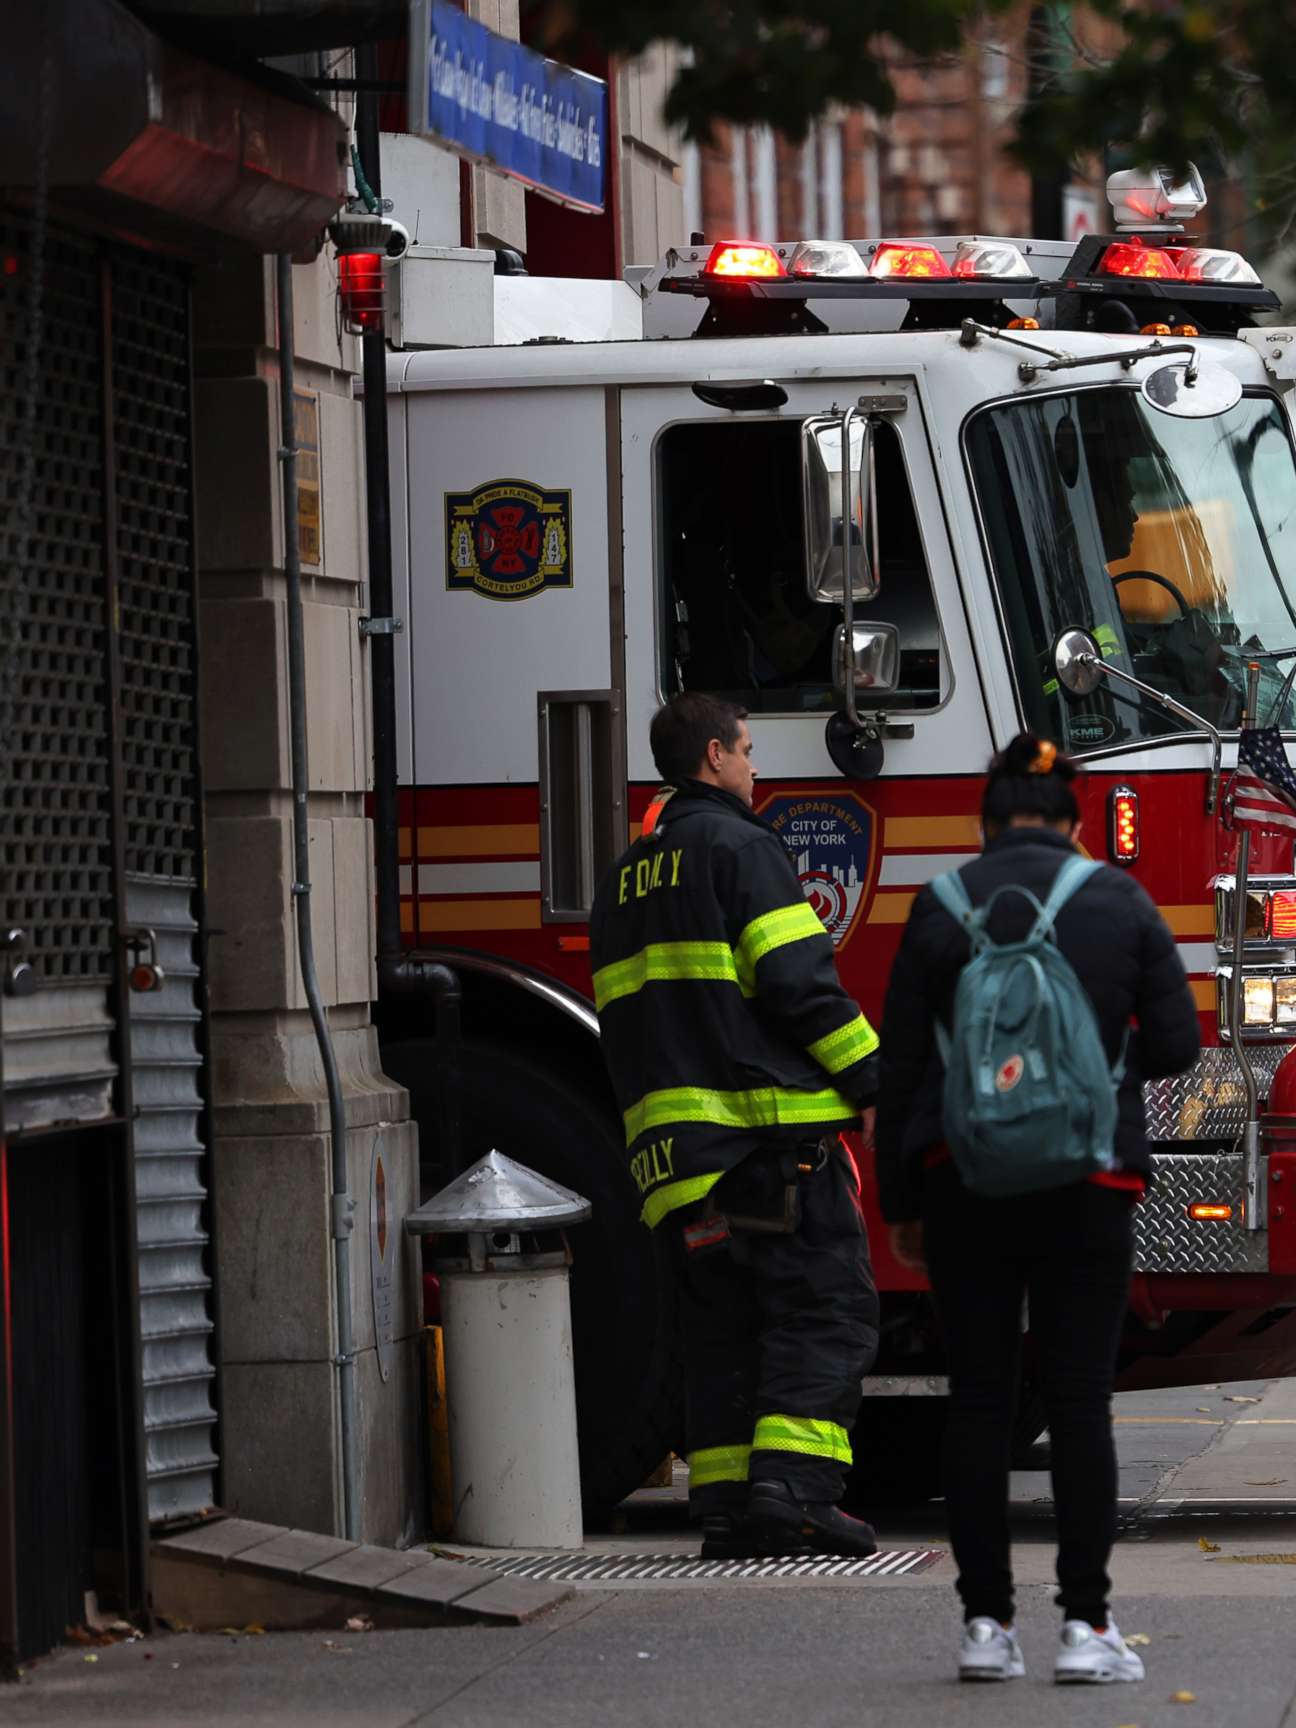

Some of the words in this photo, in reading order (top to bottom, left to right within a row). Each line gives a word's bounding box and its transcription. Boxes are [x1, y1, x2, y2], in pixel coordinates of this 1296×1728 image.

[550, 533, 558, 563] 147
[476, 576, 527, 592] CORTELYOU
[1070, 727, 1105, 736] KME
[788, 801, 864, 836] DEPARTMENT
[791, 820, 818, 832] CITY
[820, 819, 838, 832] OF
[783, 834, 810, 846] NEW
[813, 833, 847, 845] YORK
